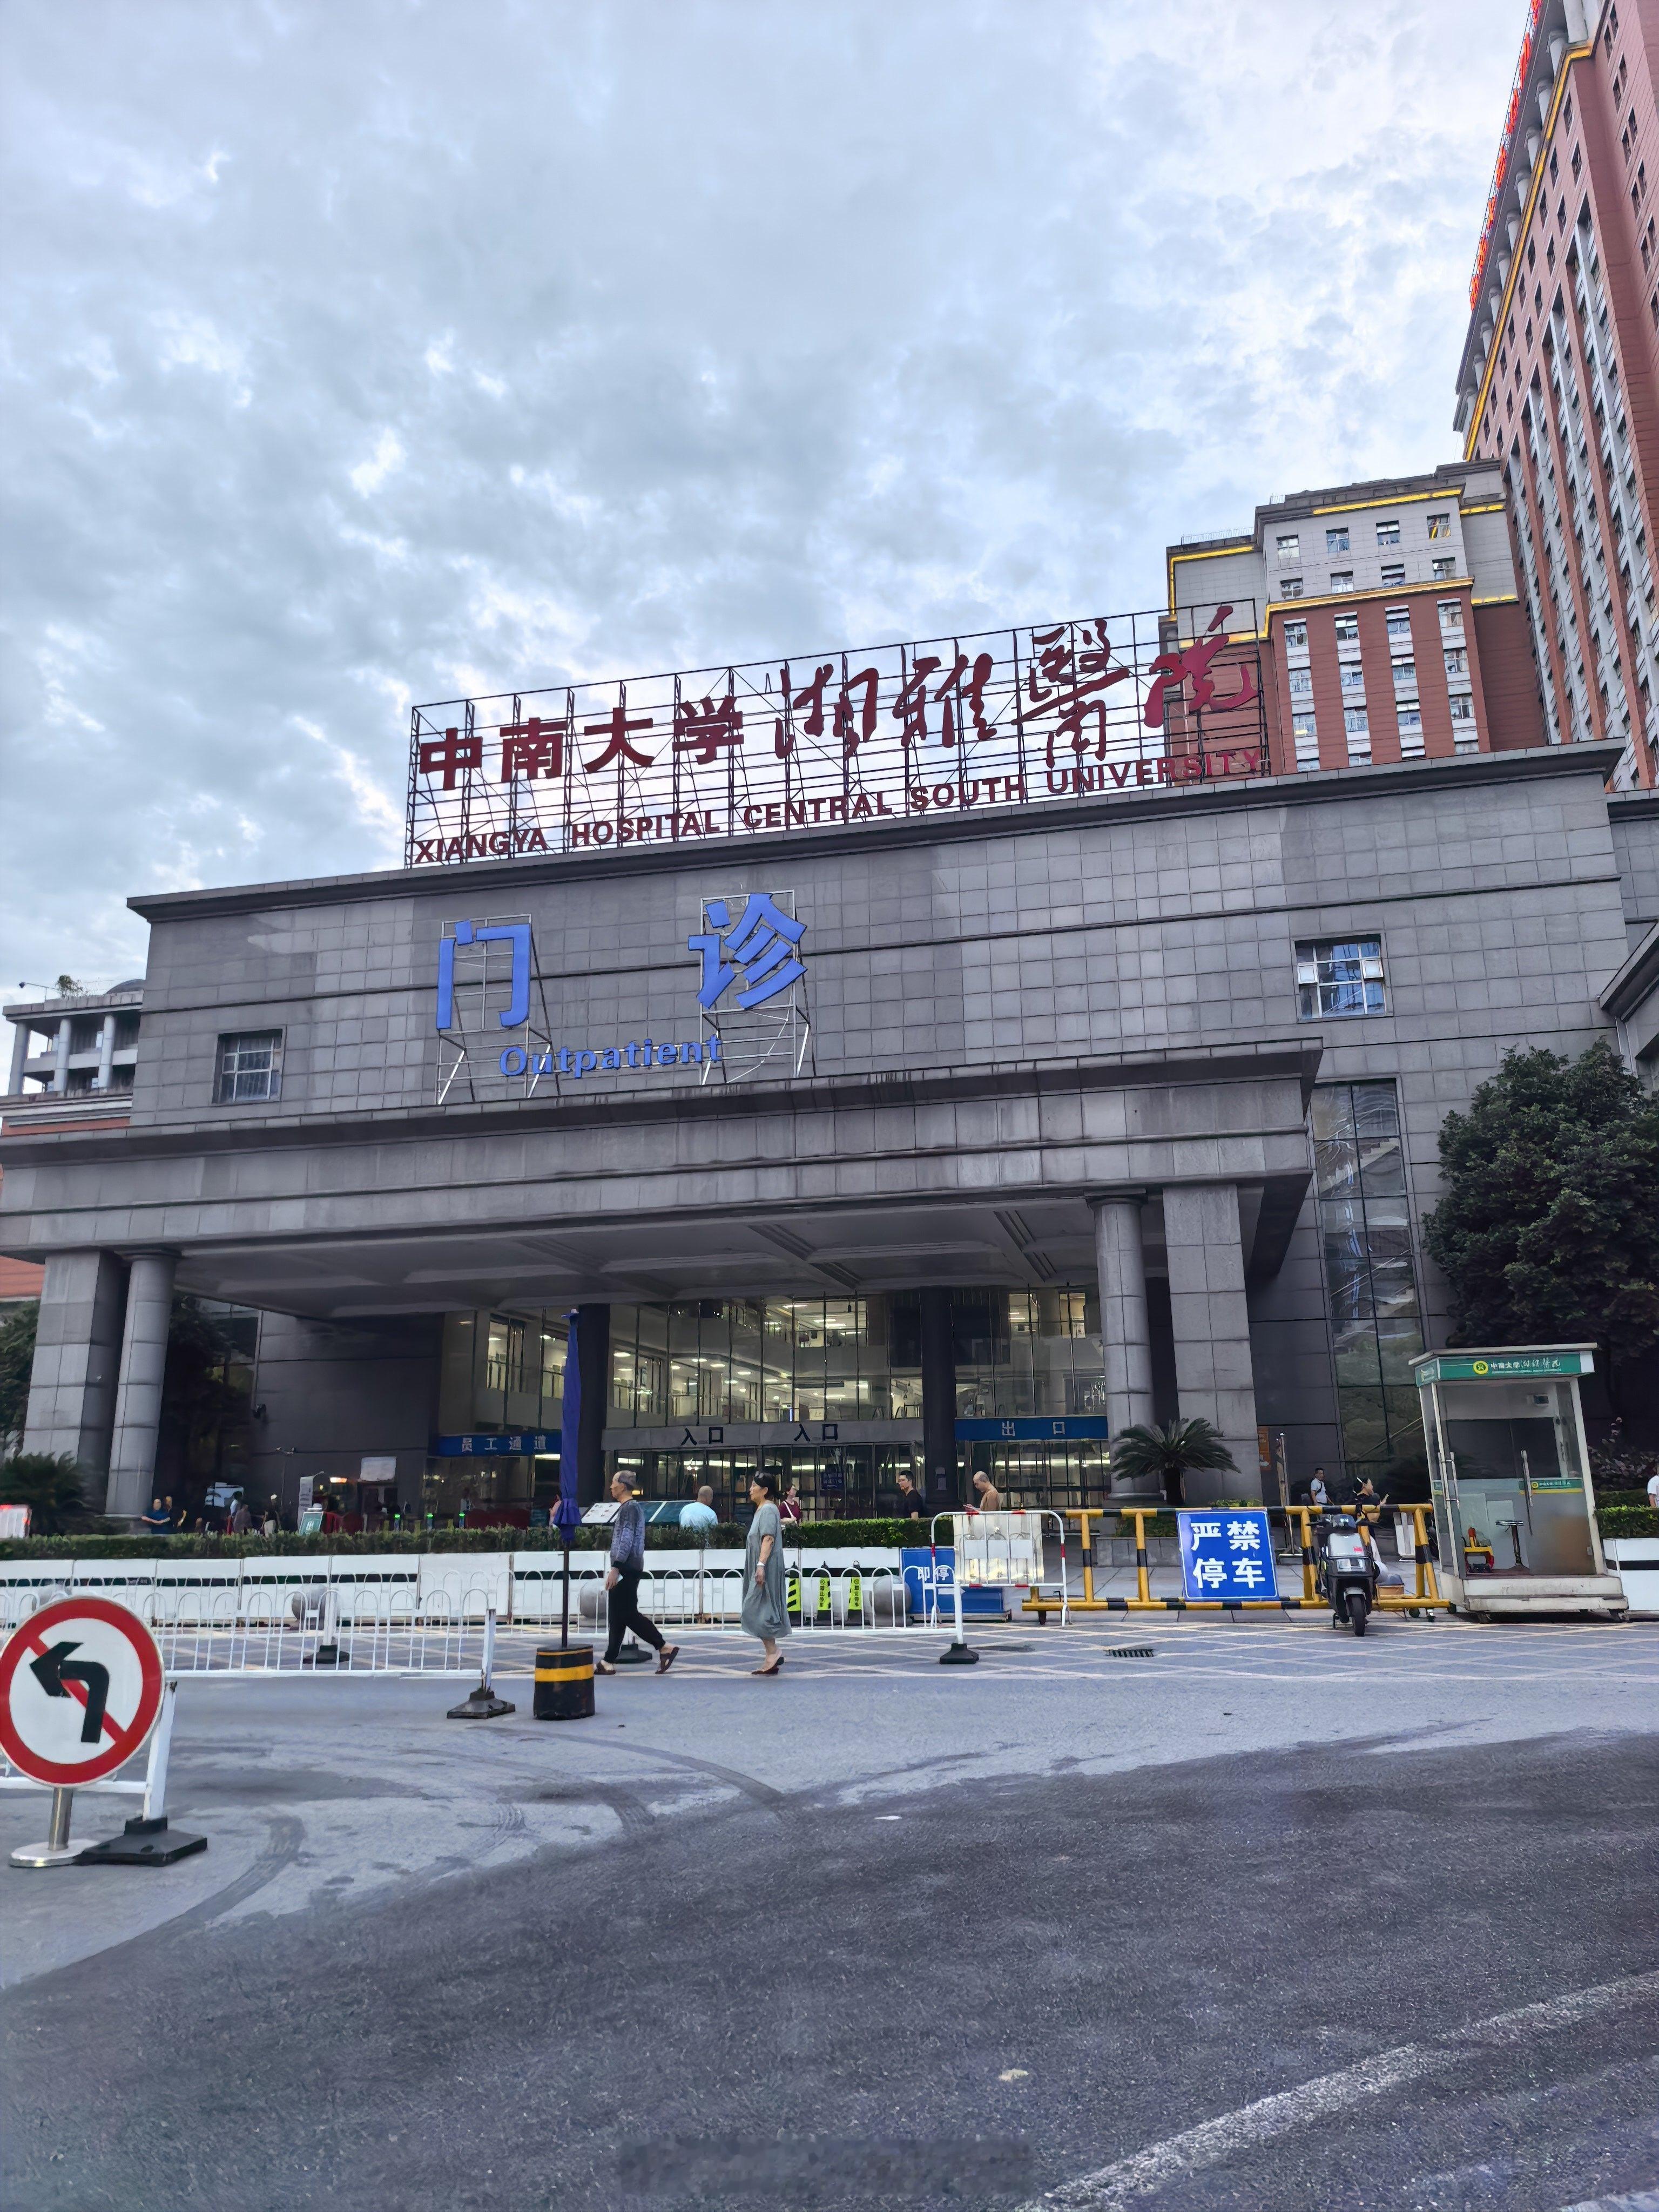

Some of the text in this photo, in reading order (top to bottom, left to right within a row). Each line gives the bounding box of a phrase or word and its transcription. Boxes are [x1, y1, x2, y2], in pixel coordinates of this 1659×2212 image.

[415, 749, 1263, 863] XIANGYA HOSPITAL CENTRAL SOUTH UNIVERSITY
[436, 893, 807, 1029] 门诊
[500, 1035, 722, 1078] Outpatient
[681, 1426, 724, 1446] 入口
[794, 1423, 838, 1442] 入口
[1002, 1420, 1065, 1436] 出口
[462, 1435, 547, 1452] 员工通道
[1190, 1521, 1260, 1551] 严禁
[1192, 1557, 1266, 1589] 停车
